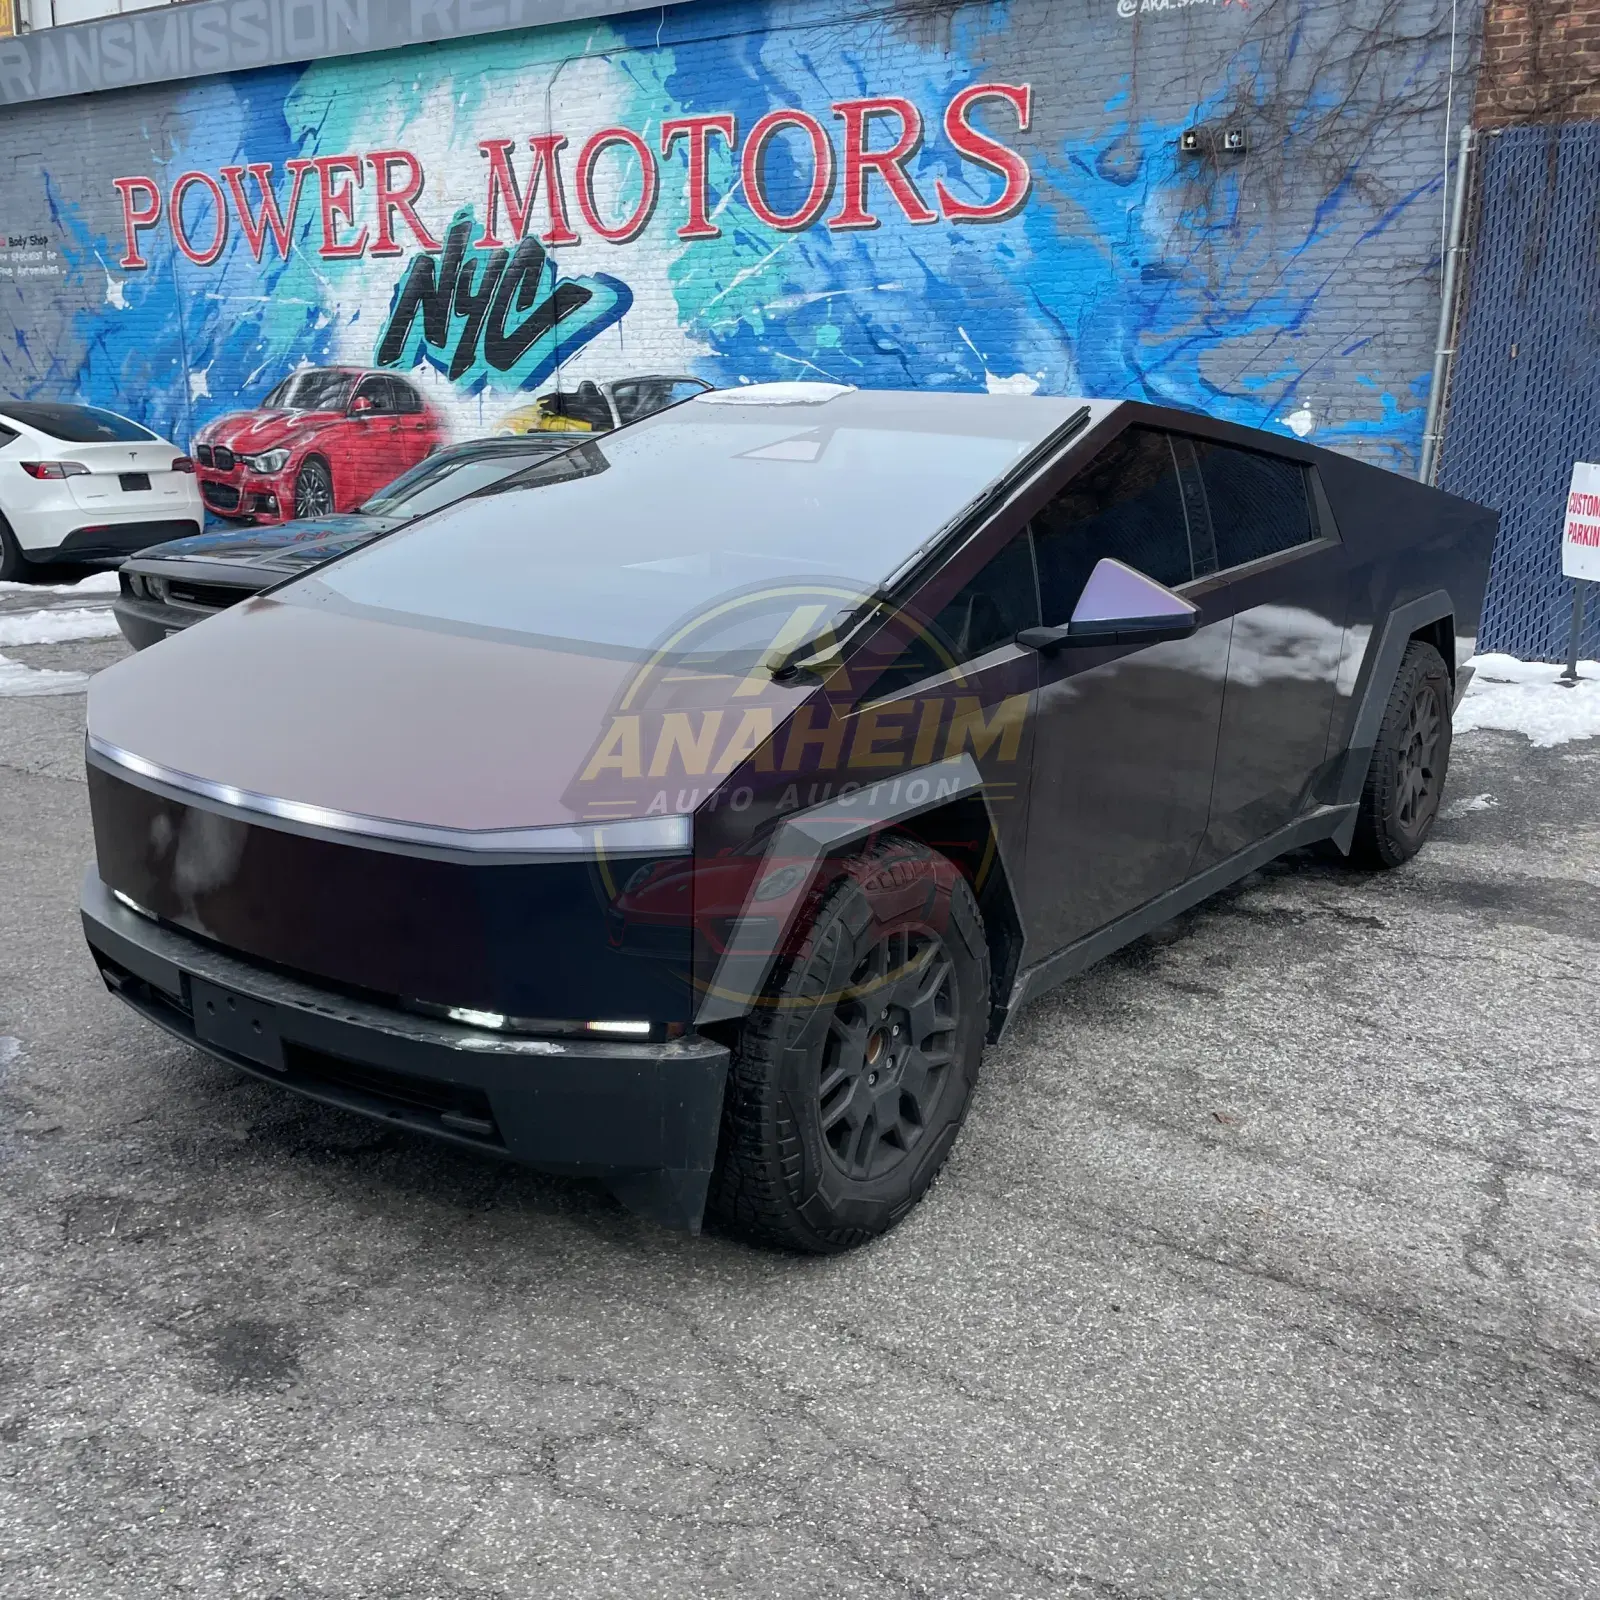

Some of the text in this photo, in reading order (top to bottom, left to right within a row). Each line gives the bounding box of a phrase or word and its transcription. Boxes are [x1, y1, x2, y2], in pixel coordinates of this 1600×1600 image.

[0, 0, 369, 101] RANSMISSION
[9, 235, 27, 250] Body
[30, 234, 48, 249] Shop
[113, 83, 1034, 270] POWER MOTORS
[375, 216, 600, 386] NYC
